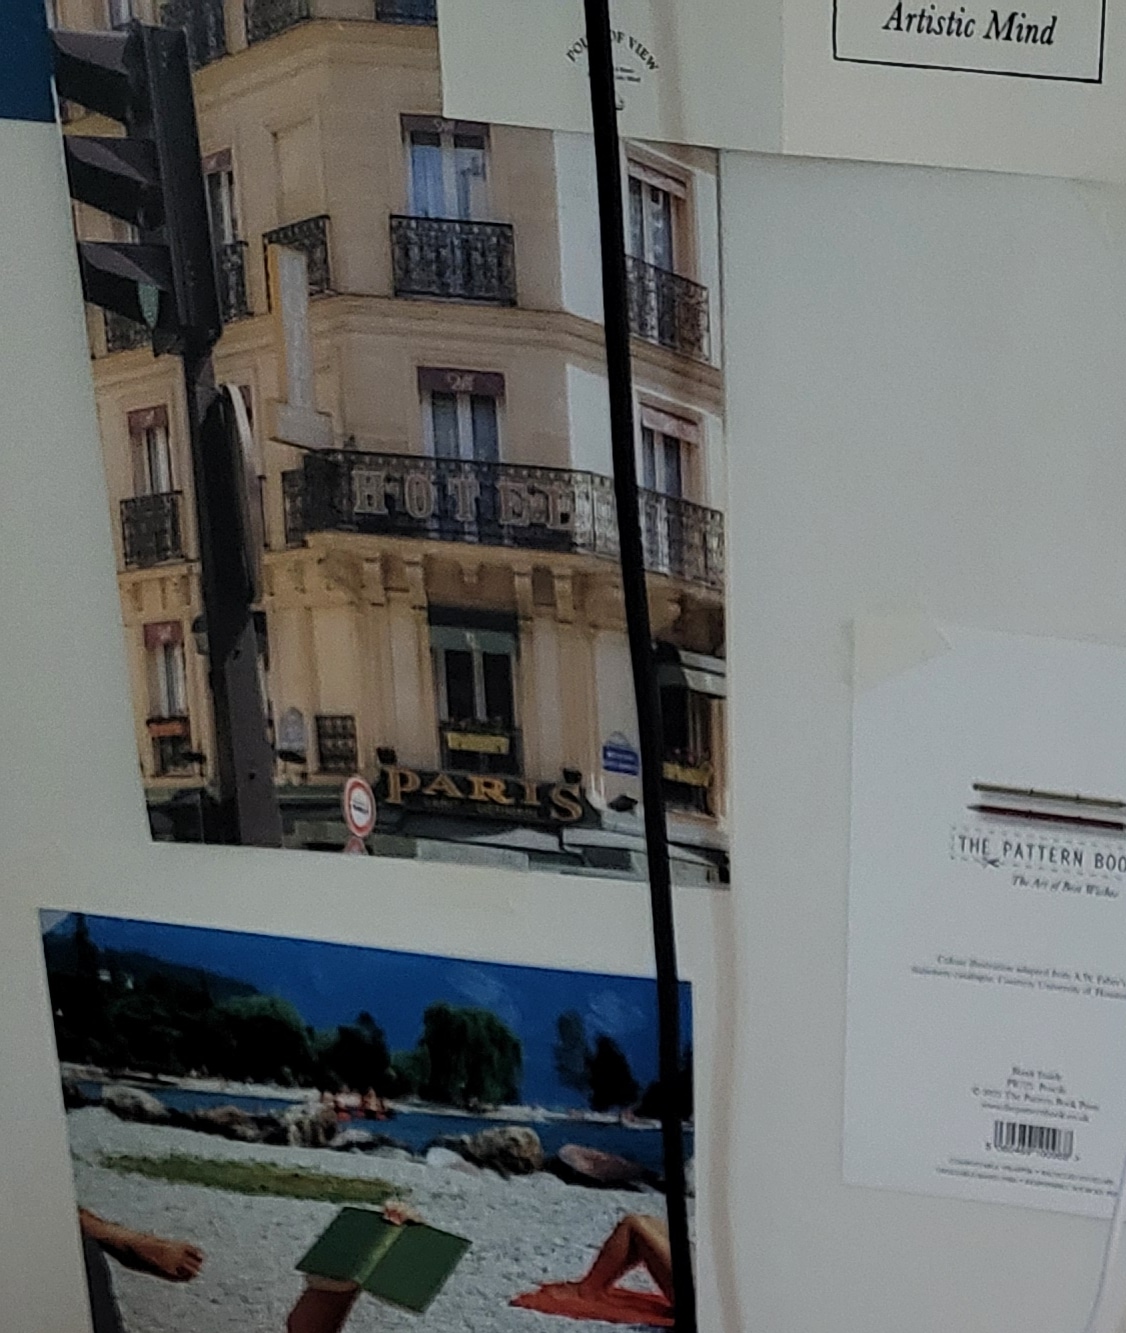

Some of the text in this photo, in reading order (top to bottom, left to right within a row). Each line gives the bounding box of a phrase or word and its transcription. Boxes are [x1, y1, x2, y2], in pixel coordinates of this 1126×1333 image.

[882, 2, 1058, 46] Artistic Mind
[628, 36, 660, 71] VIEW
[351, 468, 575, 531] HOTEL
[385, 766, 583, 822] PARIS
[958, 835, 990, 856] THE
[1003, 840, 1084, 869] PATTERN
